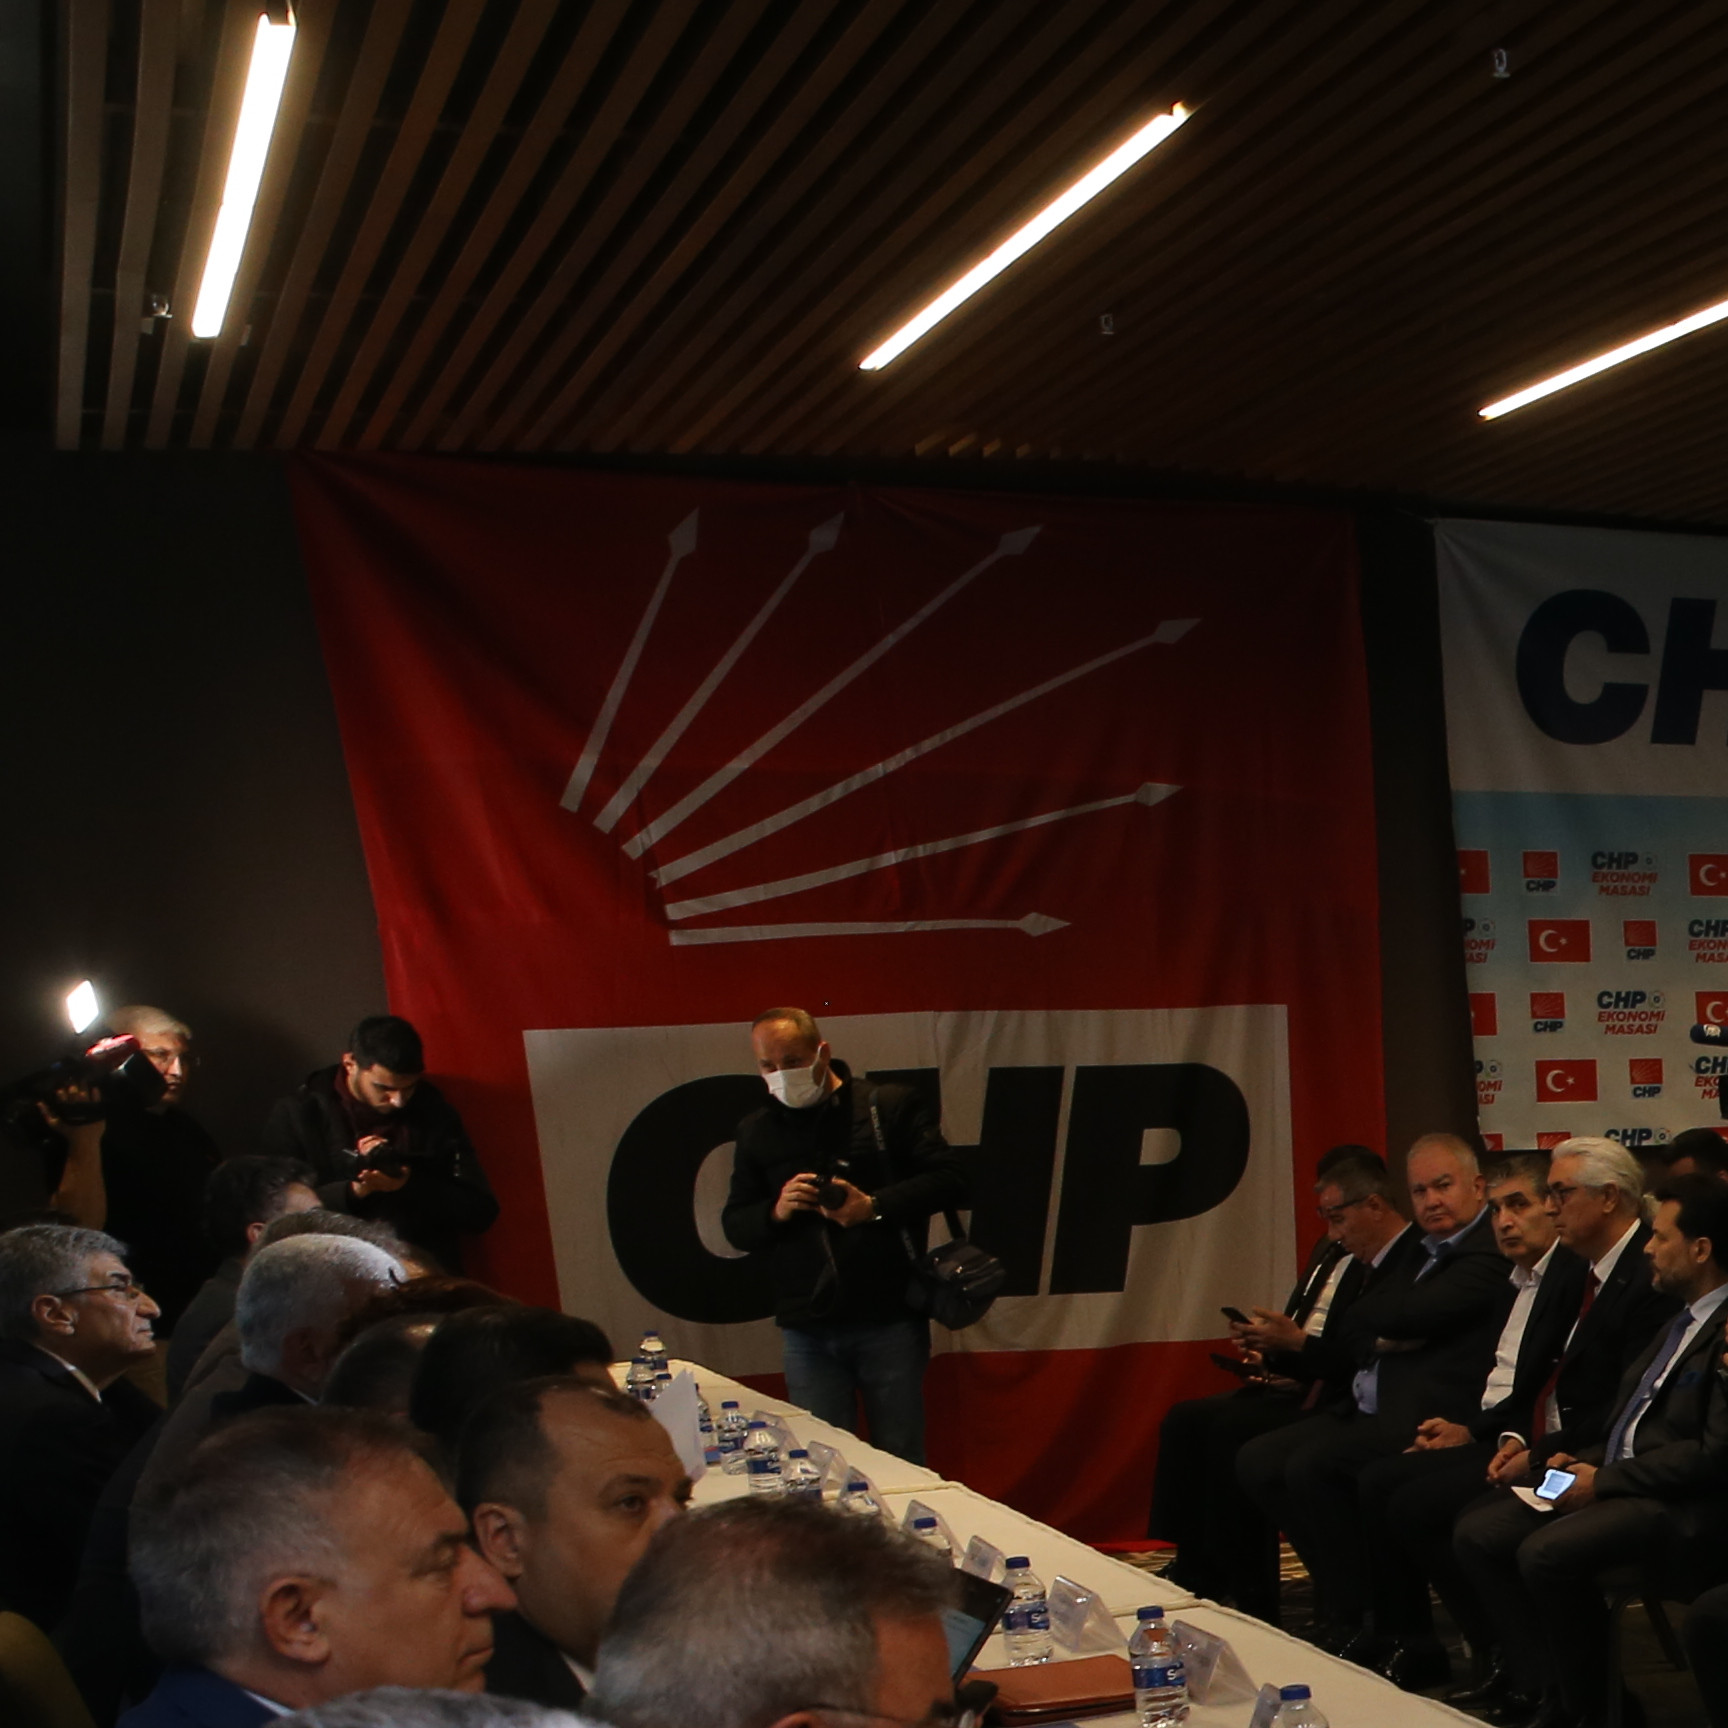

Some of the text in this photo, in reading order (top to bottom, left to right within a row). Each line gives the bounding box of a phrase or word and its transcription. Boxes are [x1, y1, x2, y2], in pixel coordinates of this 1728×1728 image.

[1591, 851, 1639, 871] CHP
[1526, 880, 1556, 893] CHP
[1598, 884, 1651, 896] MASASI
[1627, 948, 1656, 960] CHP
[1597, 990, 1647, 1010] CHP
[1533, 1020, 1564, 1033] CHP
[1604, 1023, 1658, 1035] MASASI
[1632, 1086, 1662, 1098] CHP
